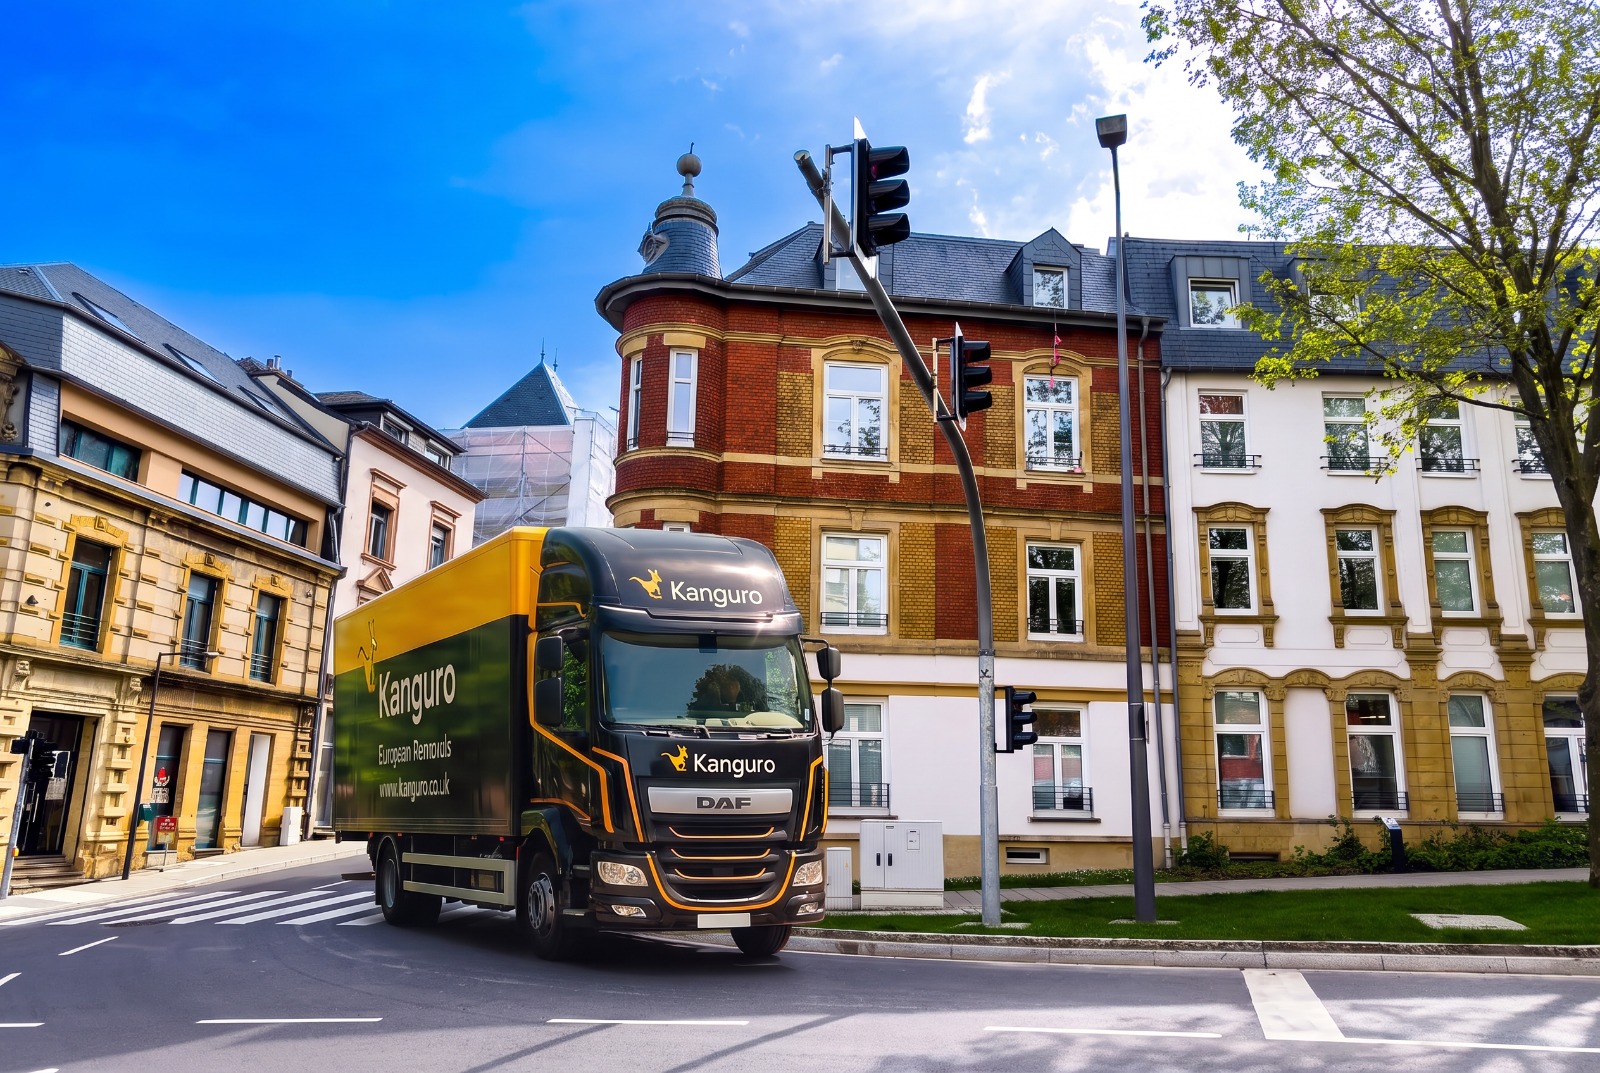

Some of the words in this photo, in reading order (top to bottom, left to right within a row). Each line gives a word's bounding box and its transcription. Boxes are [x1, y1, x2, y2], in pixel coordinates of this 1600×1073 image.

[670, 580, 763, 608] Kanguro
[379, 663, 456, 725] Kanguro
[378, 744, 411, 768] European
[694, 753, 776, 779] Kanguro
[379, 771, 450, 803] www.kanguro.co.uk
[696, 796, 752, 810] DAF
